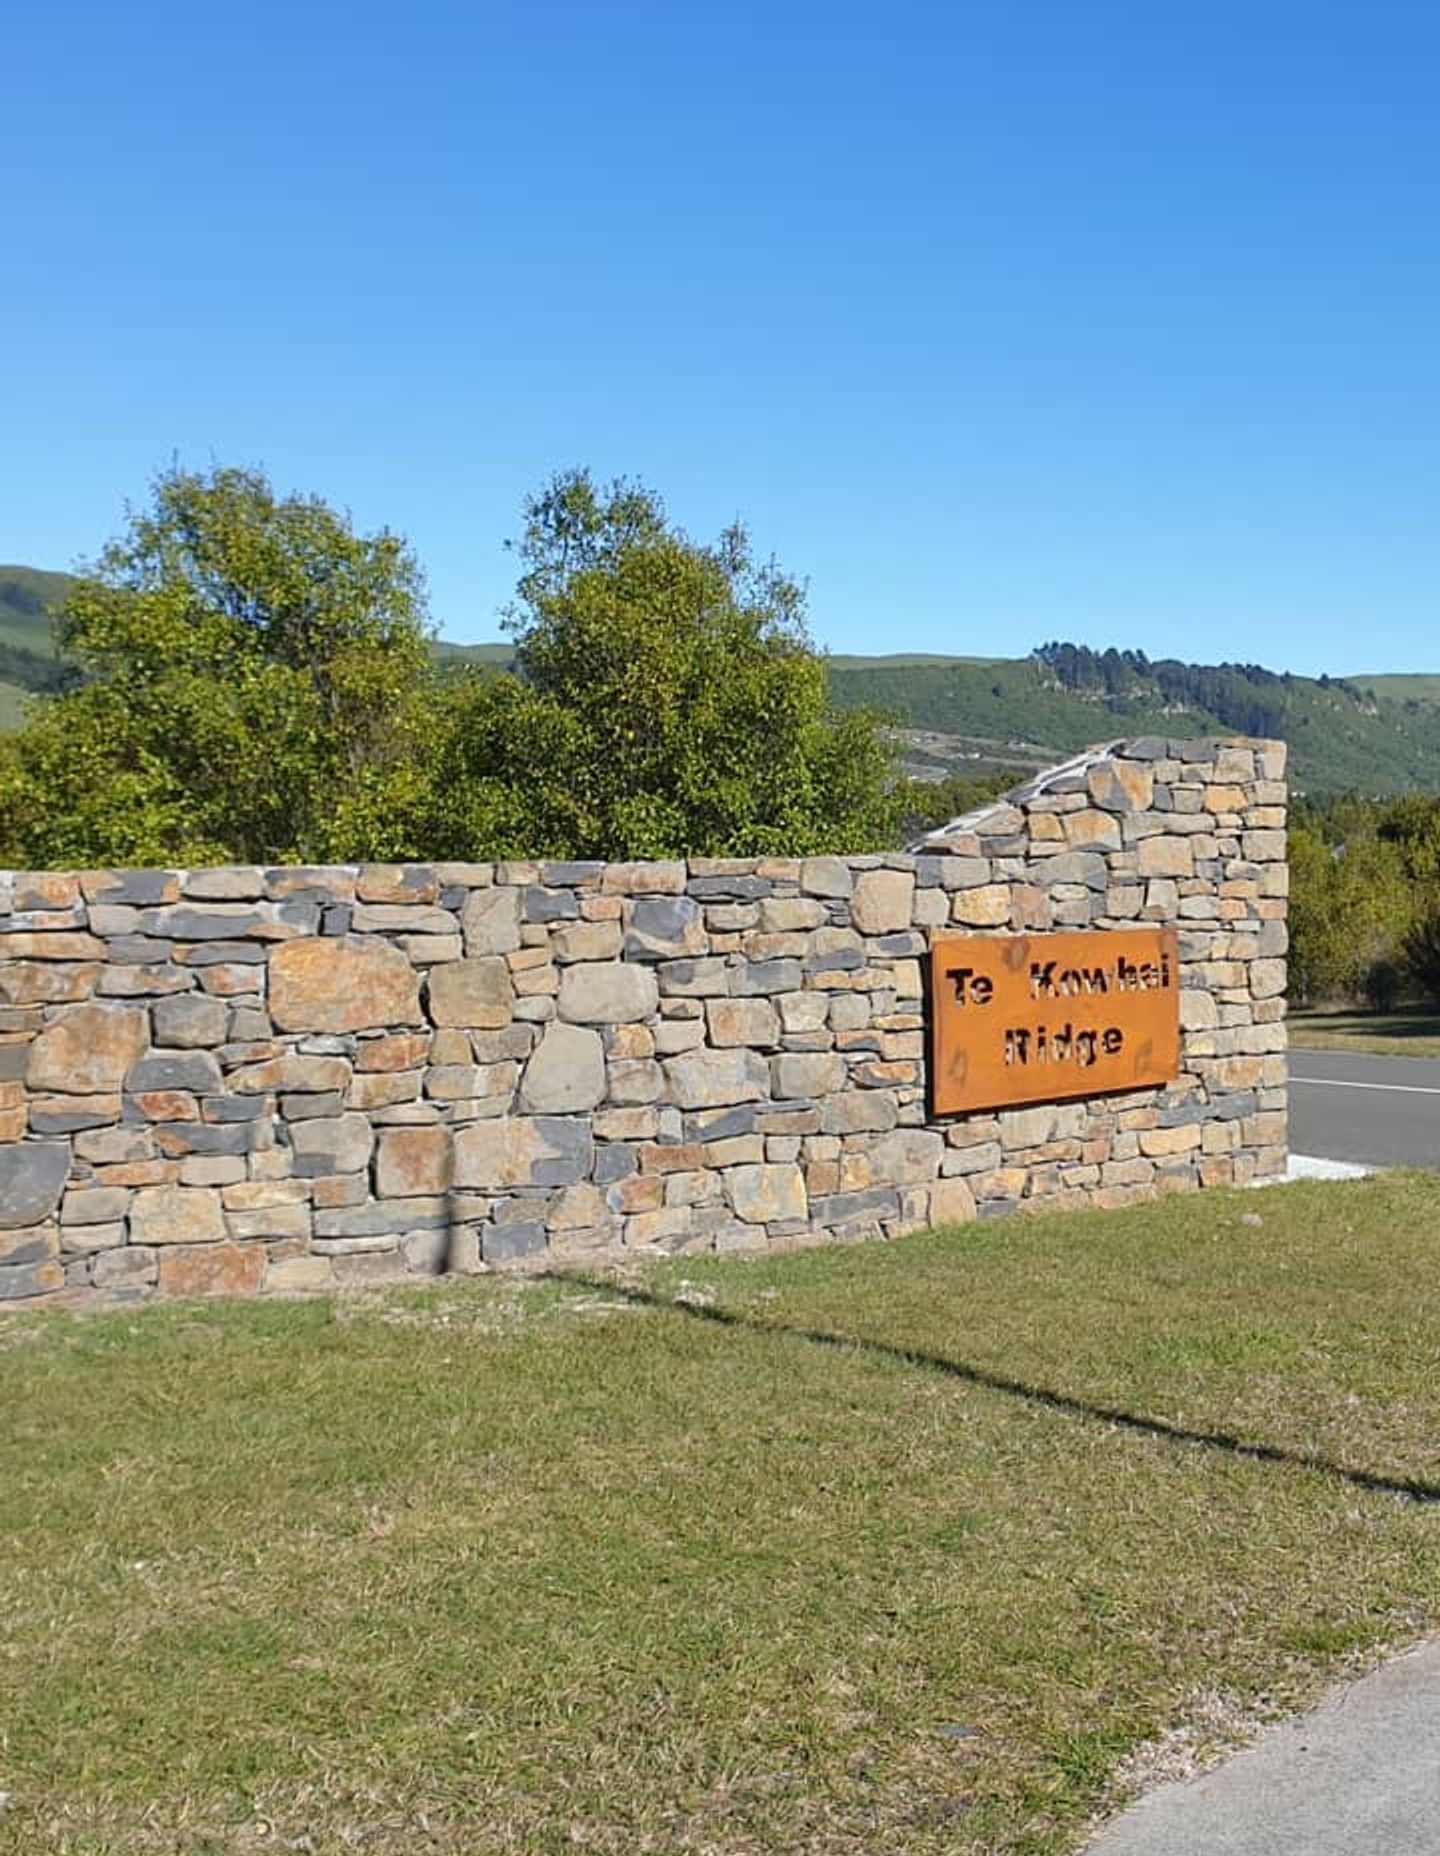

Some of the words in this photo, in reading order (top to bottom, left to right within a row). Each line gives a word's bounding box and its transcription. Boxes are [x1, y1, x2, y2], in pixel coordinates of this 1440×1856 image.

[946, 967, 993, 1005] Te
[1029, 953, 1170, 1000] Kowhai
[1004, 1023, 1124, 1067] Ridge
